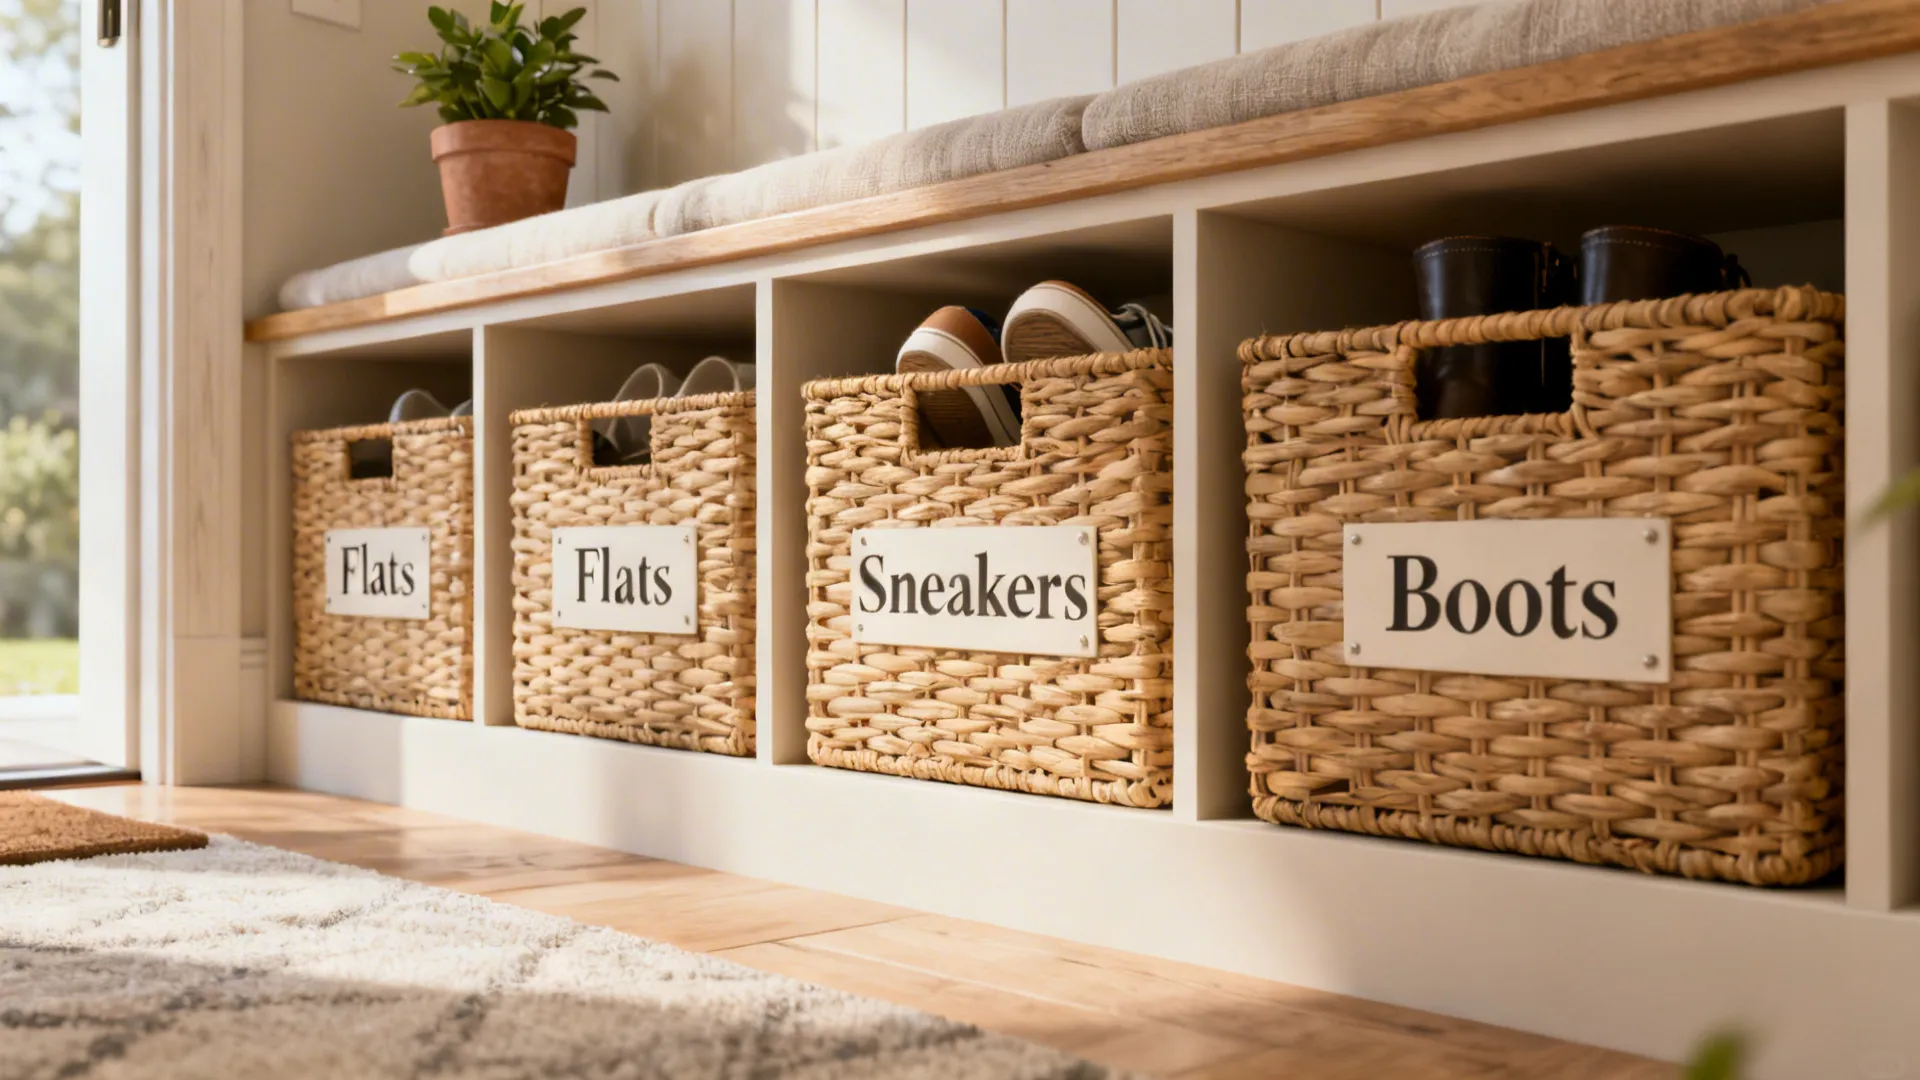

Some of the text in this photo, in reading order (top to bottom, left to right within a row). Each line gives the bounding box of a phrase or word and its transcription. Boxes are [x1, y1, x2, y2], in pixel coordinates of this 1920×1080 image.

[341, 543, 415, 596] Flats
[575, 546, 673, 606] Flats
[858, 551, 1089, 621] Sneakers
[1385, 554, 1620, 641] Boots
